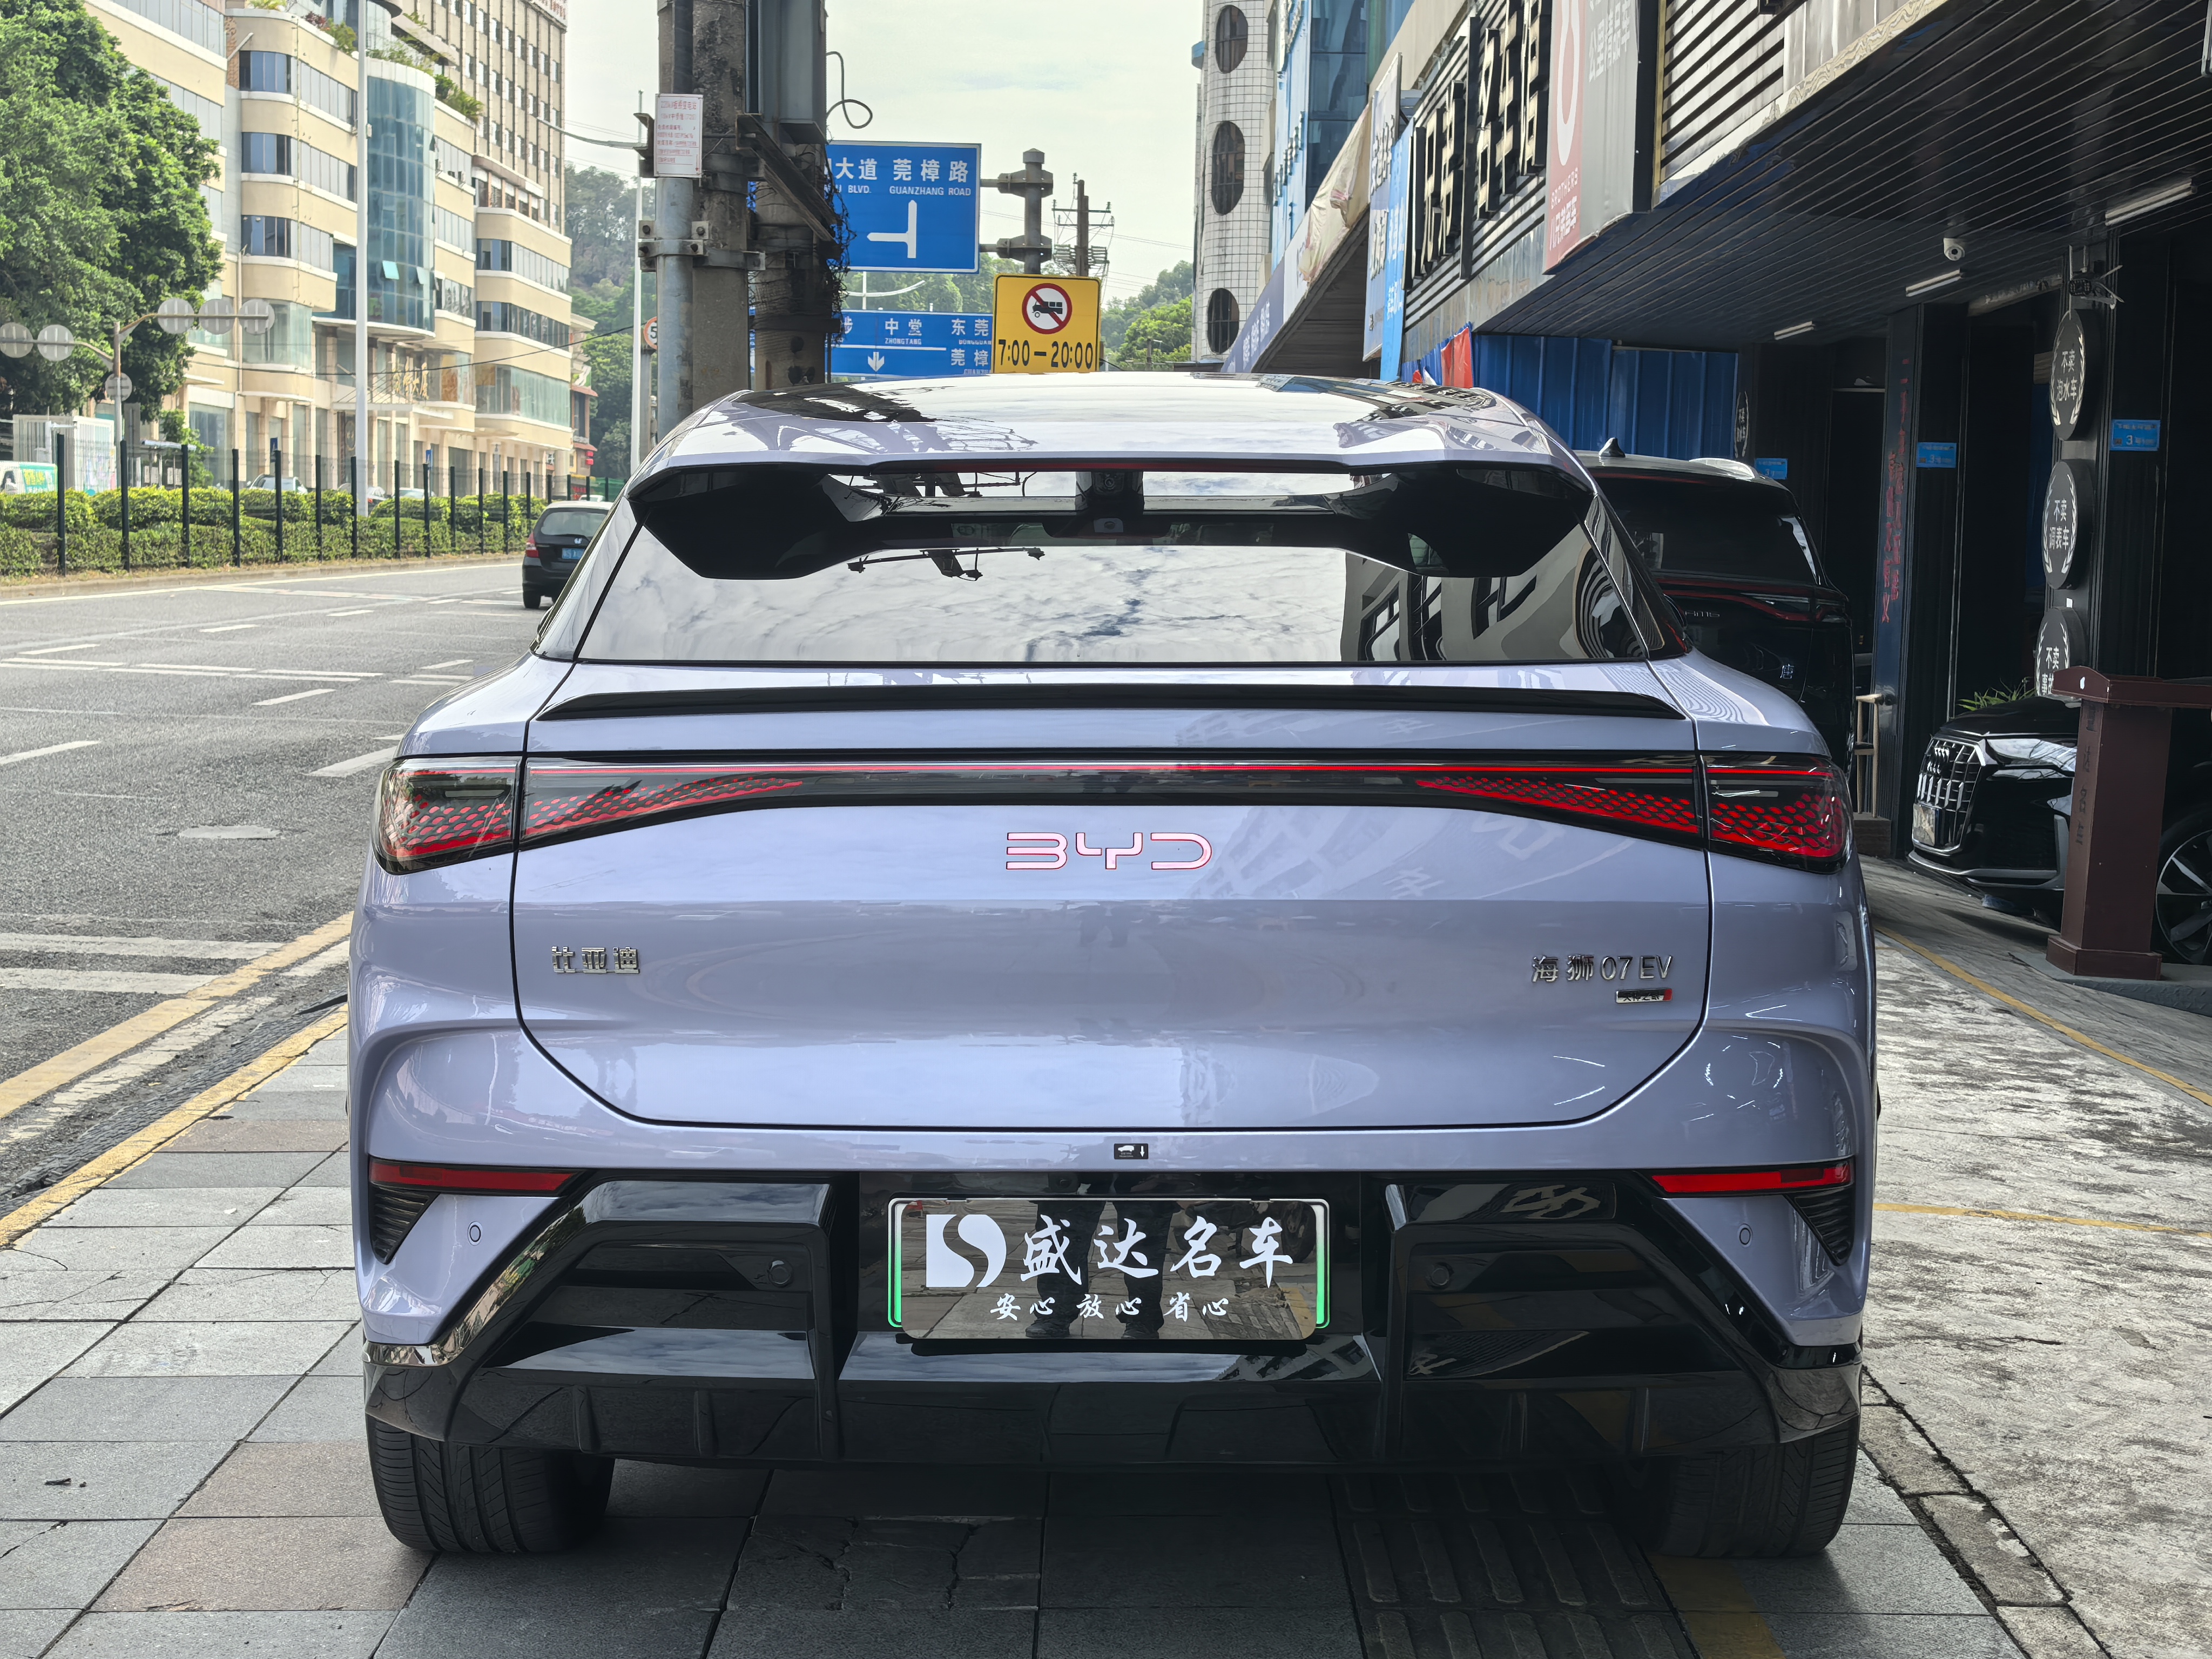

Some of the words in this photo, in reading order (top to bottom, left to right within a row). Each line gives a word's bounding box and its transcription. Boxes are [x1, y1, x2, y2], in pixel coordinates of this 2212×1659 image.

[893, 158, 968, 183] 莞樟路
[889, 186, 944, 195] GUANZHANG
[948, 187, 972, 196] ROAD
[885, 318, 922, 336] 中堂
[951, 318, 989, 336] 东莞
[2061, 349, 2075, 373] 不卖
[2056, 377, 2078, 401] 泡水车
[2053, 498, 2067, 523] 不卖
[2045, 646, 2060, 669] 不卖
[1006, 832, 1212, 870] BYD
[551, 945, 640, 974] 比亚迪
[1020, 1214, 1293, 1288] 盛达名车
